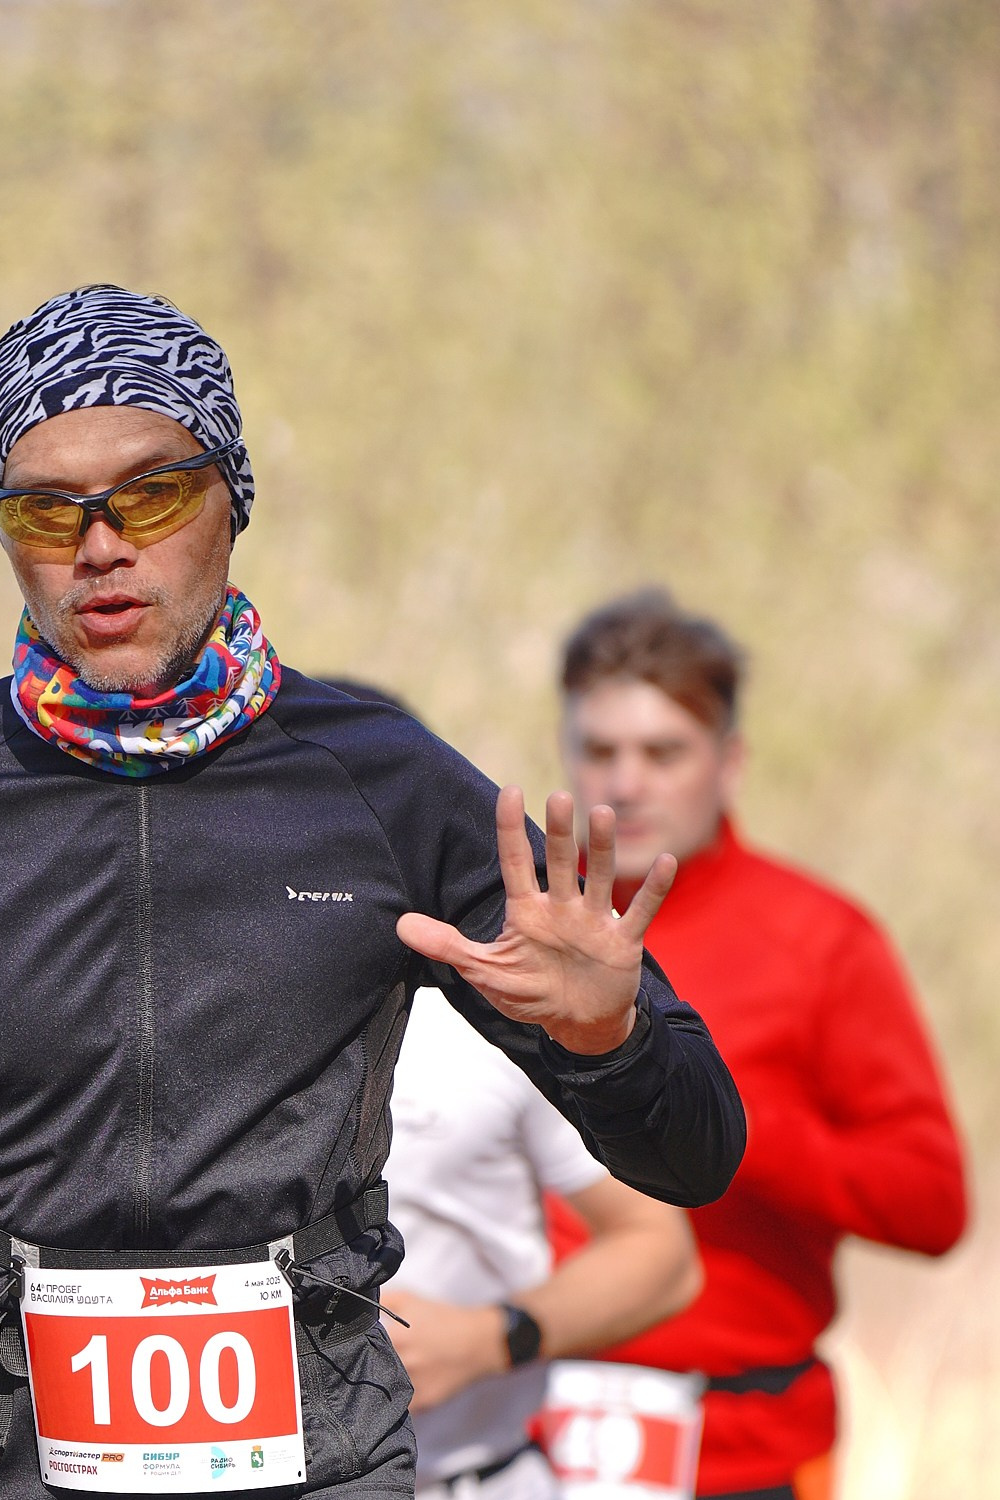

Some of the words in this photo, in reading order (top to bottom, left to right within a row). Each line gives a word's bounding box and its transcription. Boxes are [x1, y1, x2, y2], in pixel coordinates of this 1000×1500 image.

[46, 1284, 82, 1294] ПРОБЕГ
[149, 1285, 183, 1299] Альфа
[183, 1285, 209, 1296] Банк
[30, 1293, 75, 1304] ВАСИЛИЯ
[259, 1291, 269, 1301] 10
[70, 1331, 257, 1428] 100
[102, 1453, 124, 1462] PRO
[142, 1452, 180, 1461] СИБУР
[49, 1460, 98, 1475] РОСГОССТРАХ
[142, 1463, 181, 1471] ФОРМУЛА
